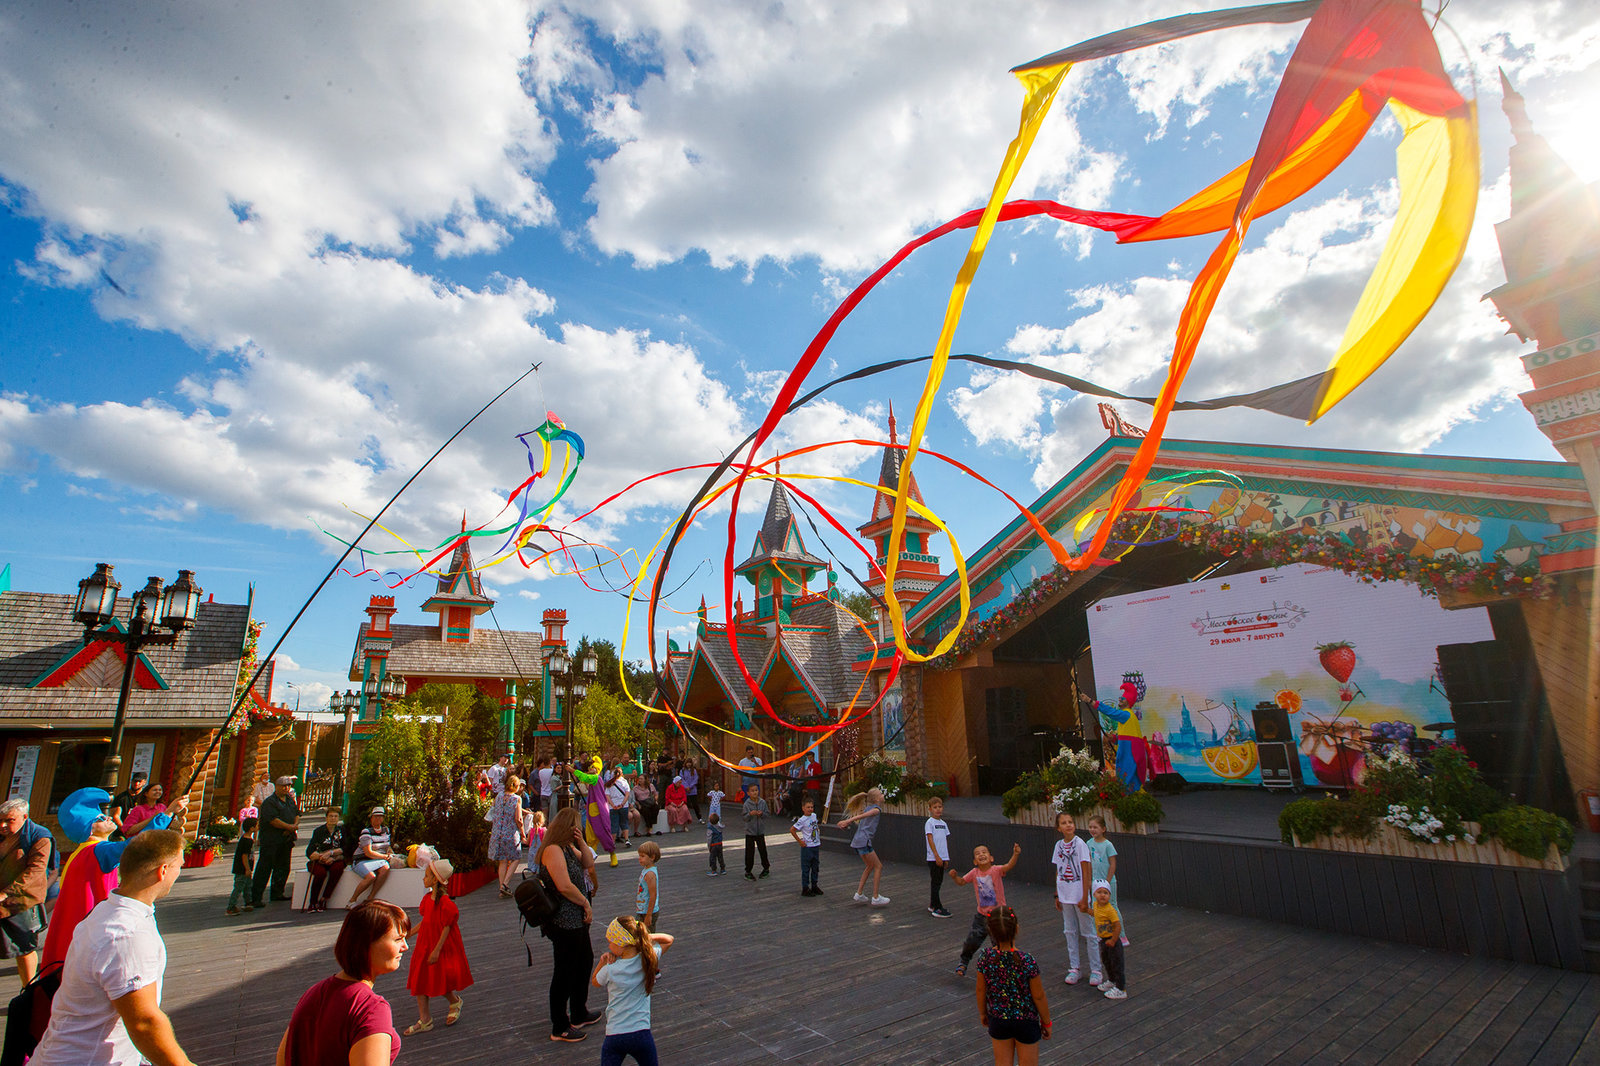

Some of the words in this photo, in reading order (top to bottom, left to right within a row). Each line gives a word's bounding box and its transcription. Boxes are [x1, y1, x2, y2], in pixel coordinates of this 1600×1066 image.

[1210, 638, 1219, 646] 29
[1221, 637, 1241, 645] июля
[1254, 632, 1284, 641] августа
